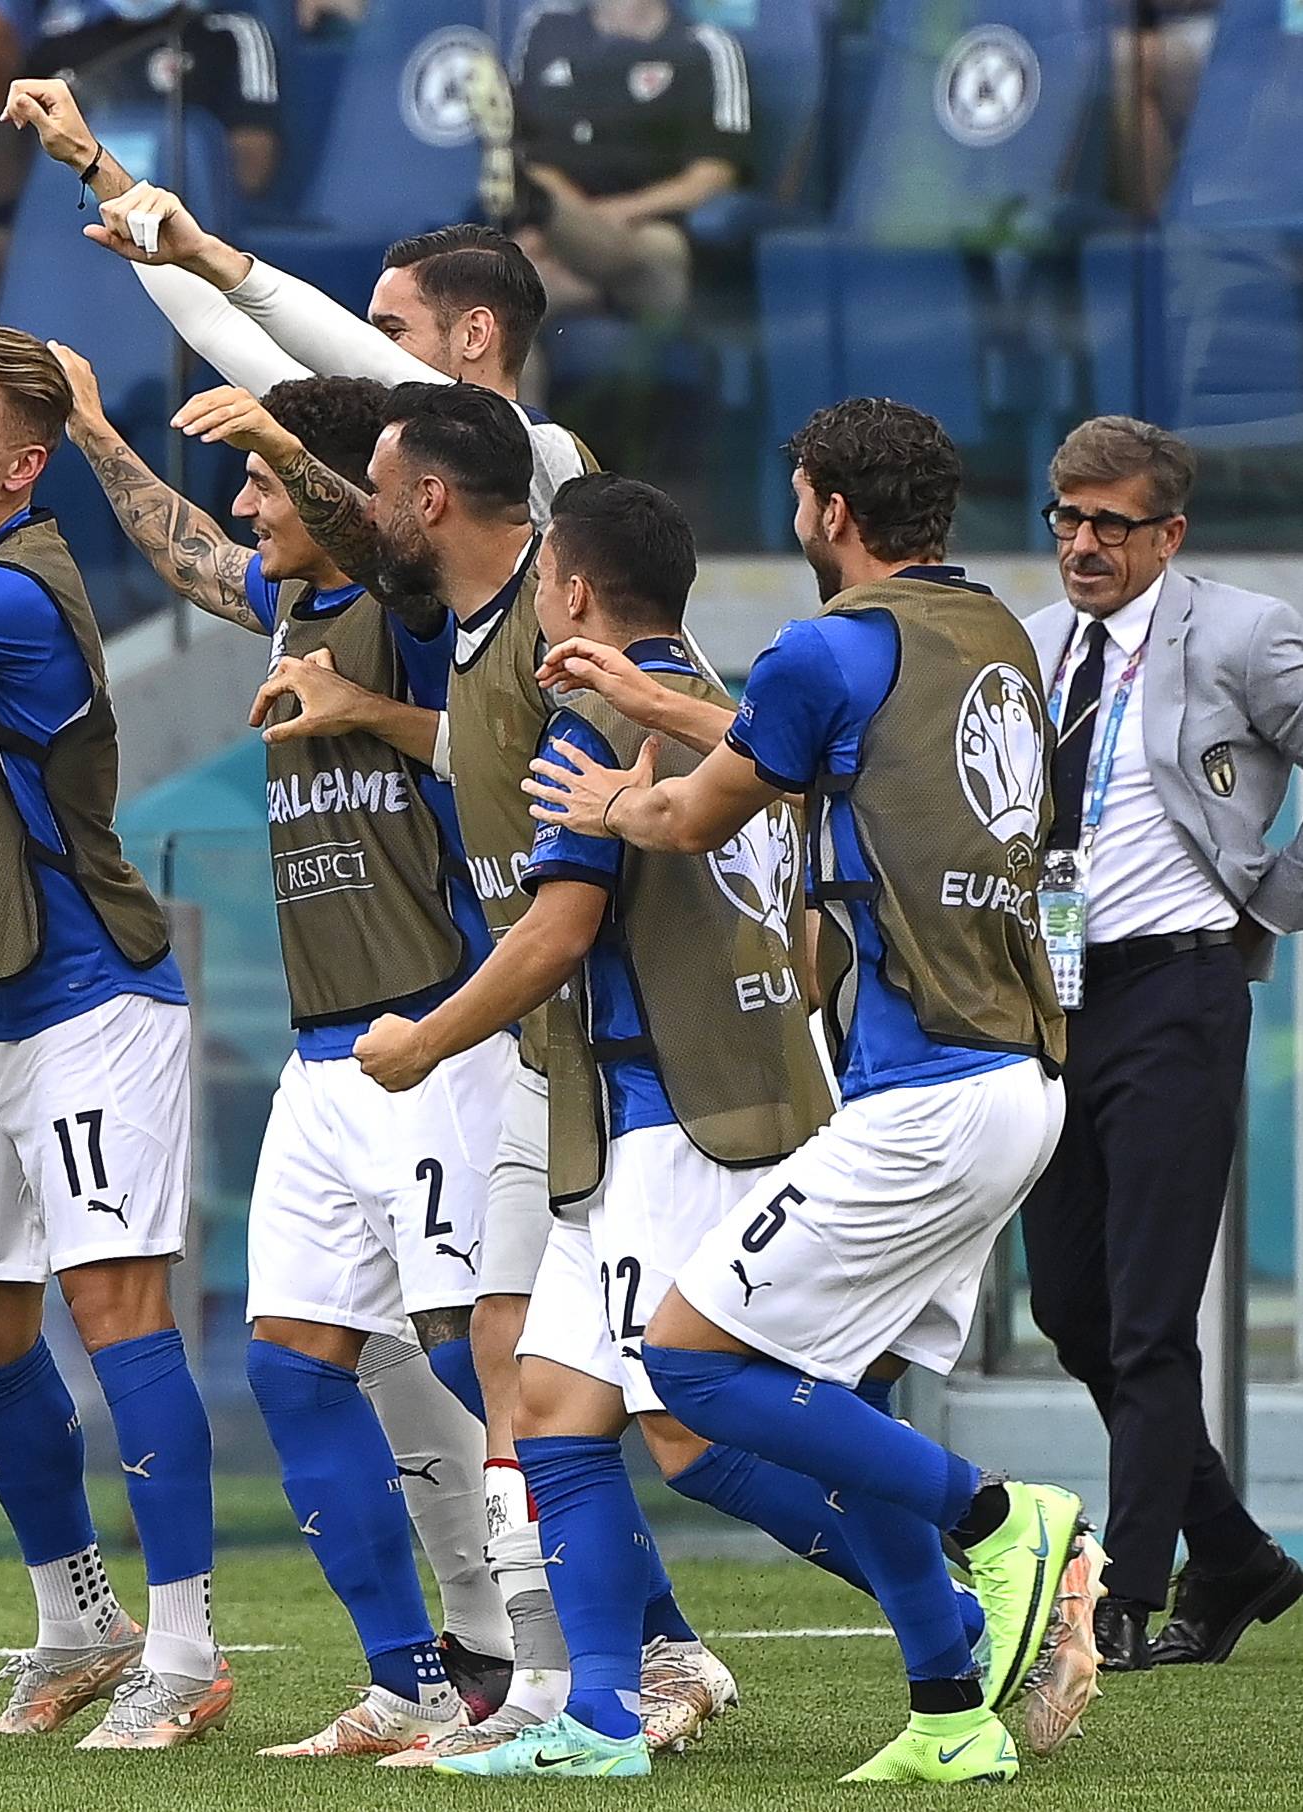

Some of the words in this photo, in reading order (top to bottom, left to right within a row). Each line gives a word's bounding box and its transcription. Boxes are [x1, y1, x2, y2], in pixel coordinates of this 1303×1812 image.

[310, 767, 410, 814] GAME
[52, 1107, 109, 1199] 17
[415, 1157, 454, 1240] 2
[741, 1182, 808, 1254] 5
